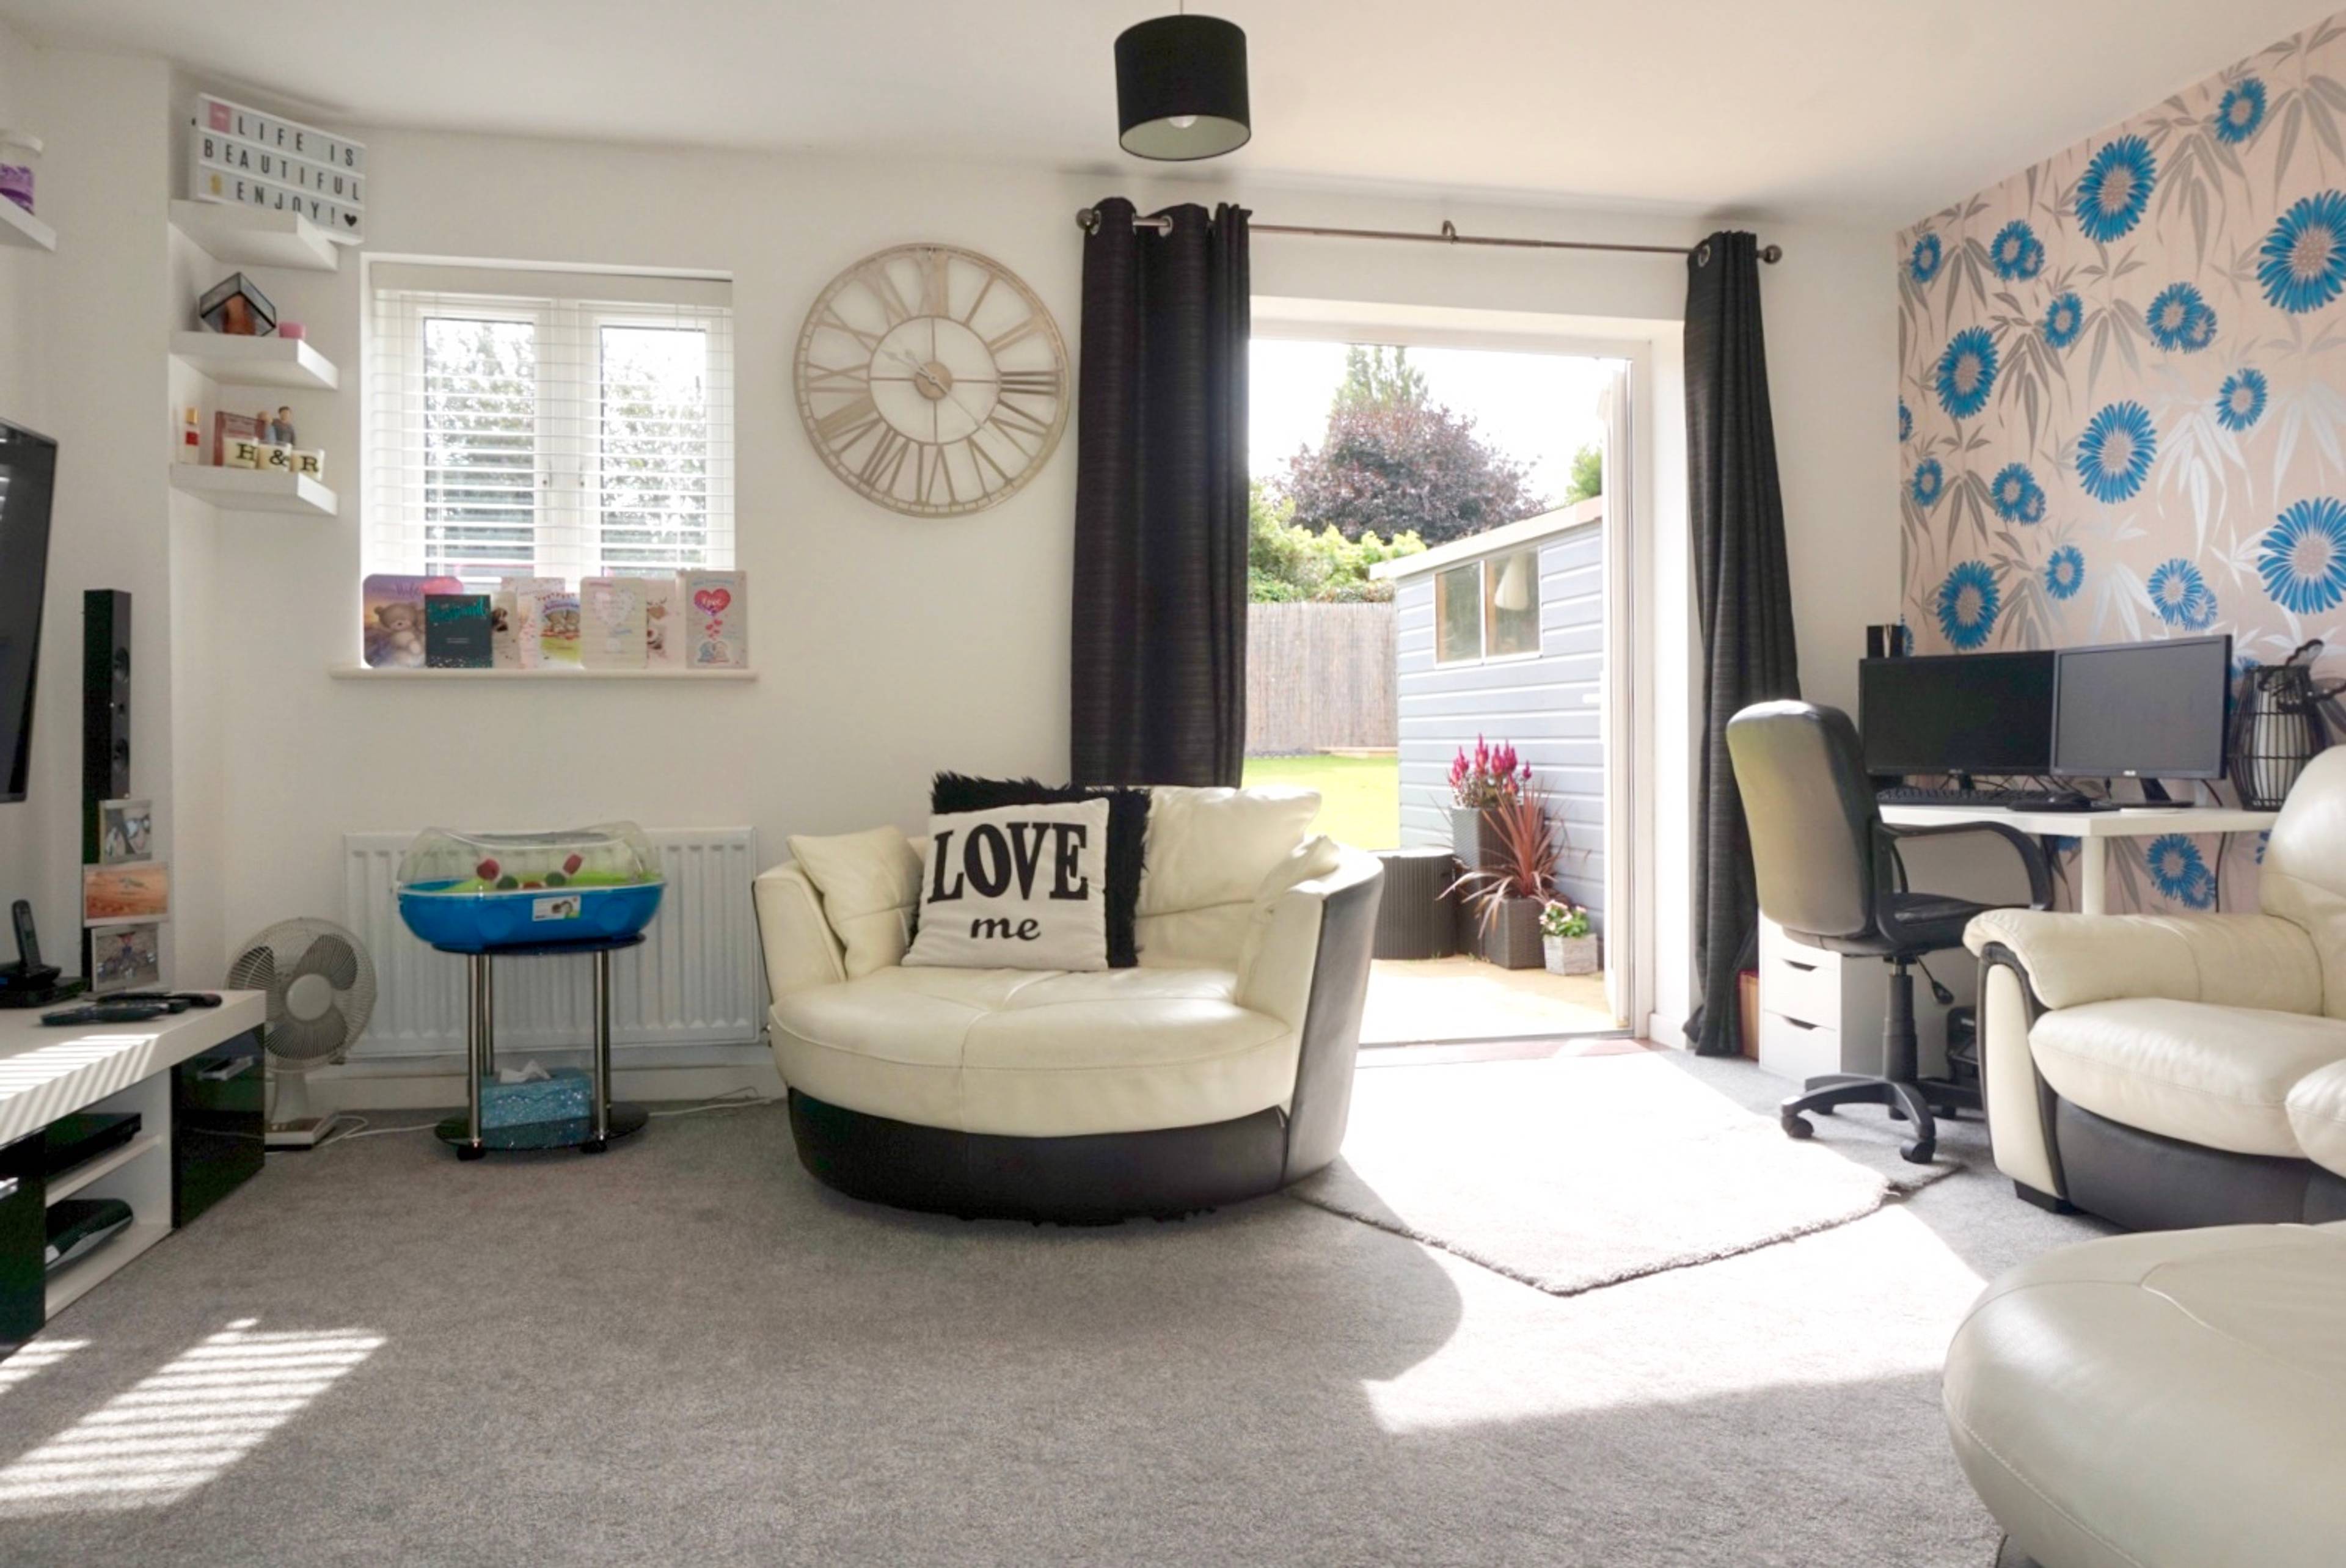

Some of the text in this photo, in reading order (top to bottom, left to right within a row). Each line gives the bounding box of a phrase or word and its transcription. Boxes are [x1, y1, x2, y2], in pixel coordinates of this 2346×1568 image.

[238, 116, 354, 167] LIFE IS
[203, 138, 359, 201] BEAUTIFUL
[236, 442, 257, 461] H
[301, 456, 319, 473] R
[927, 822, 1088, 904] LOVE
[970, 917, 1041, 941] me
